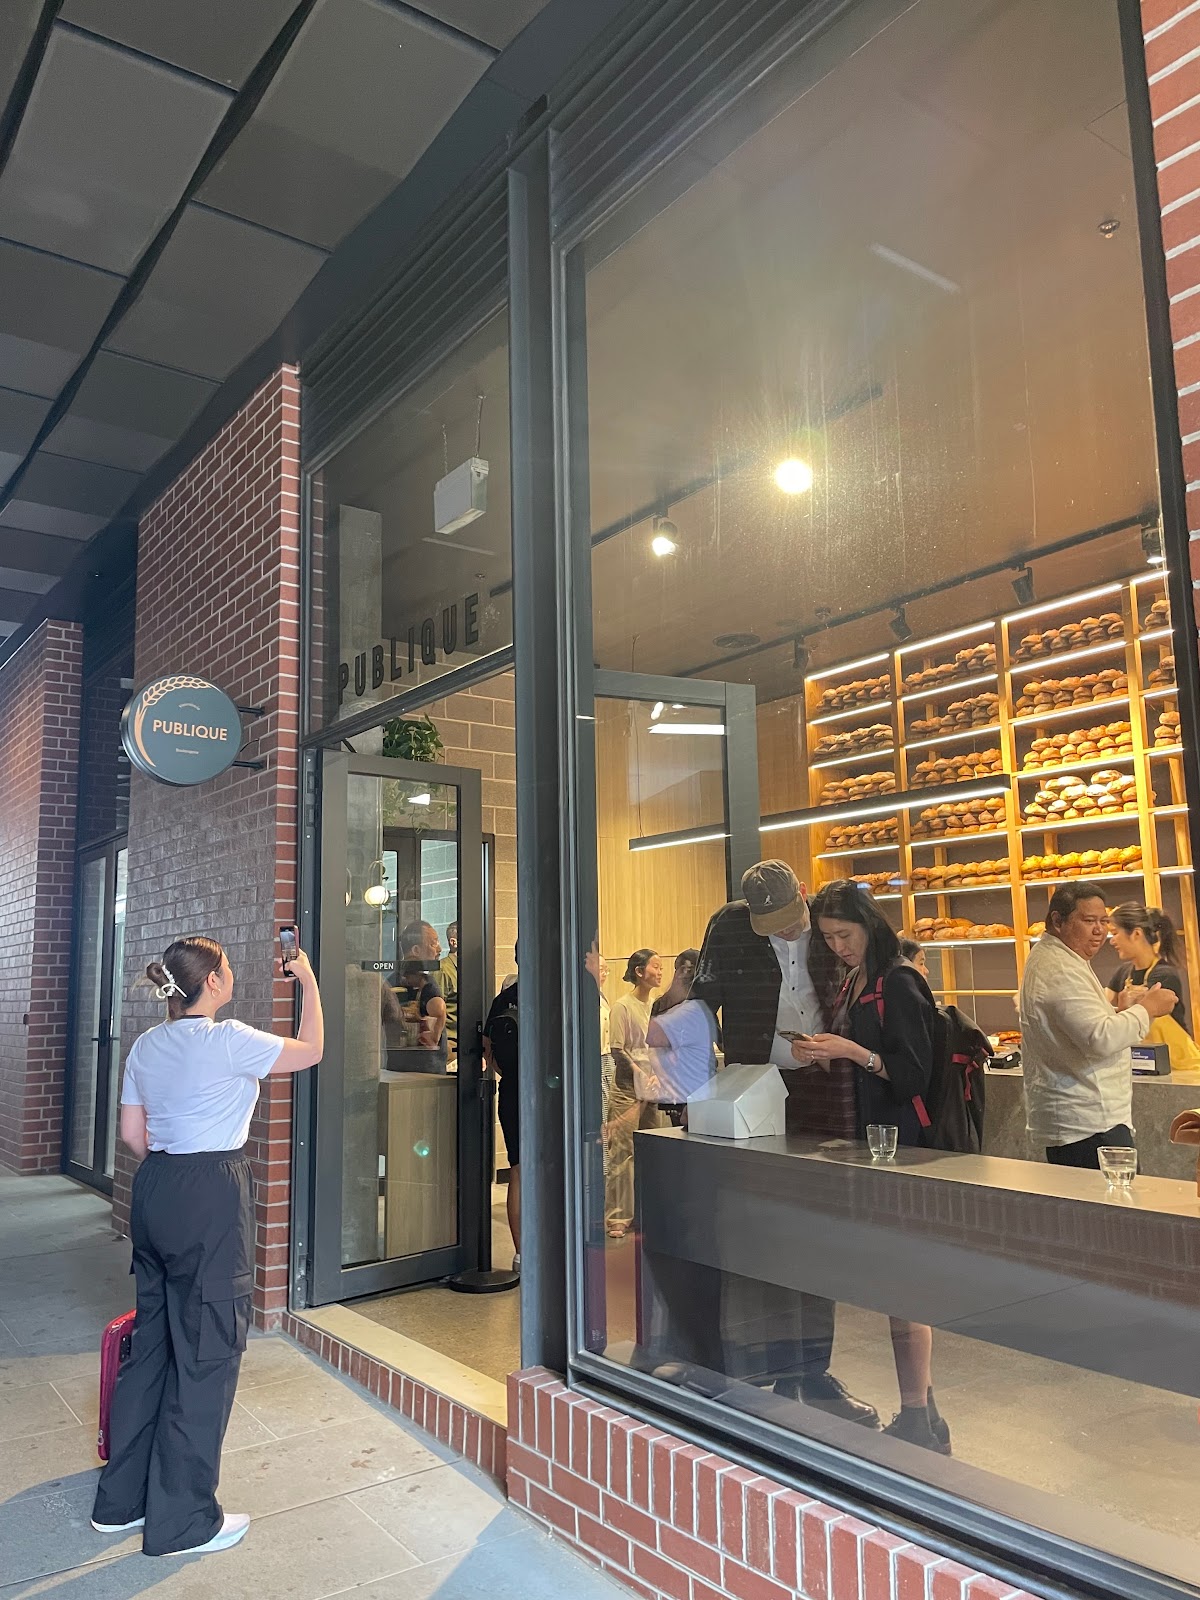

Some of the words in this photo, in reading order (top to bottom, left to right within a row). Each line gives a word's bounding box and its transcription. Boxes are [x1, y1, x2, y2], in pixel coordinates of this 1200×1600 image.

[338, 593, 479, 706] PUBLIQUE
[152, 719, 228, 741] PUBLIQUE
[373, 962, 394, 970] OPEN
